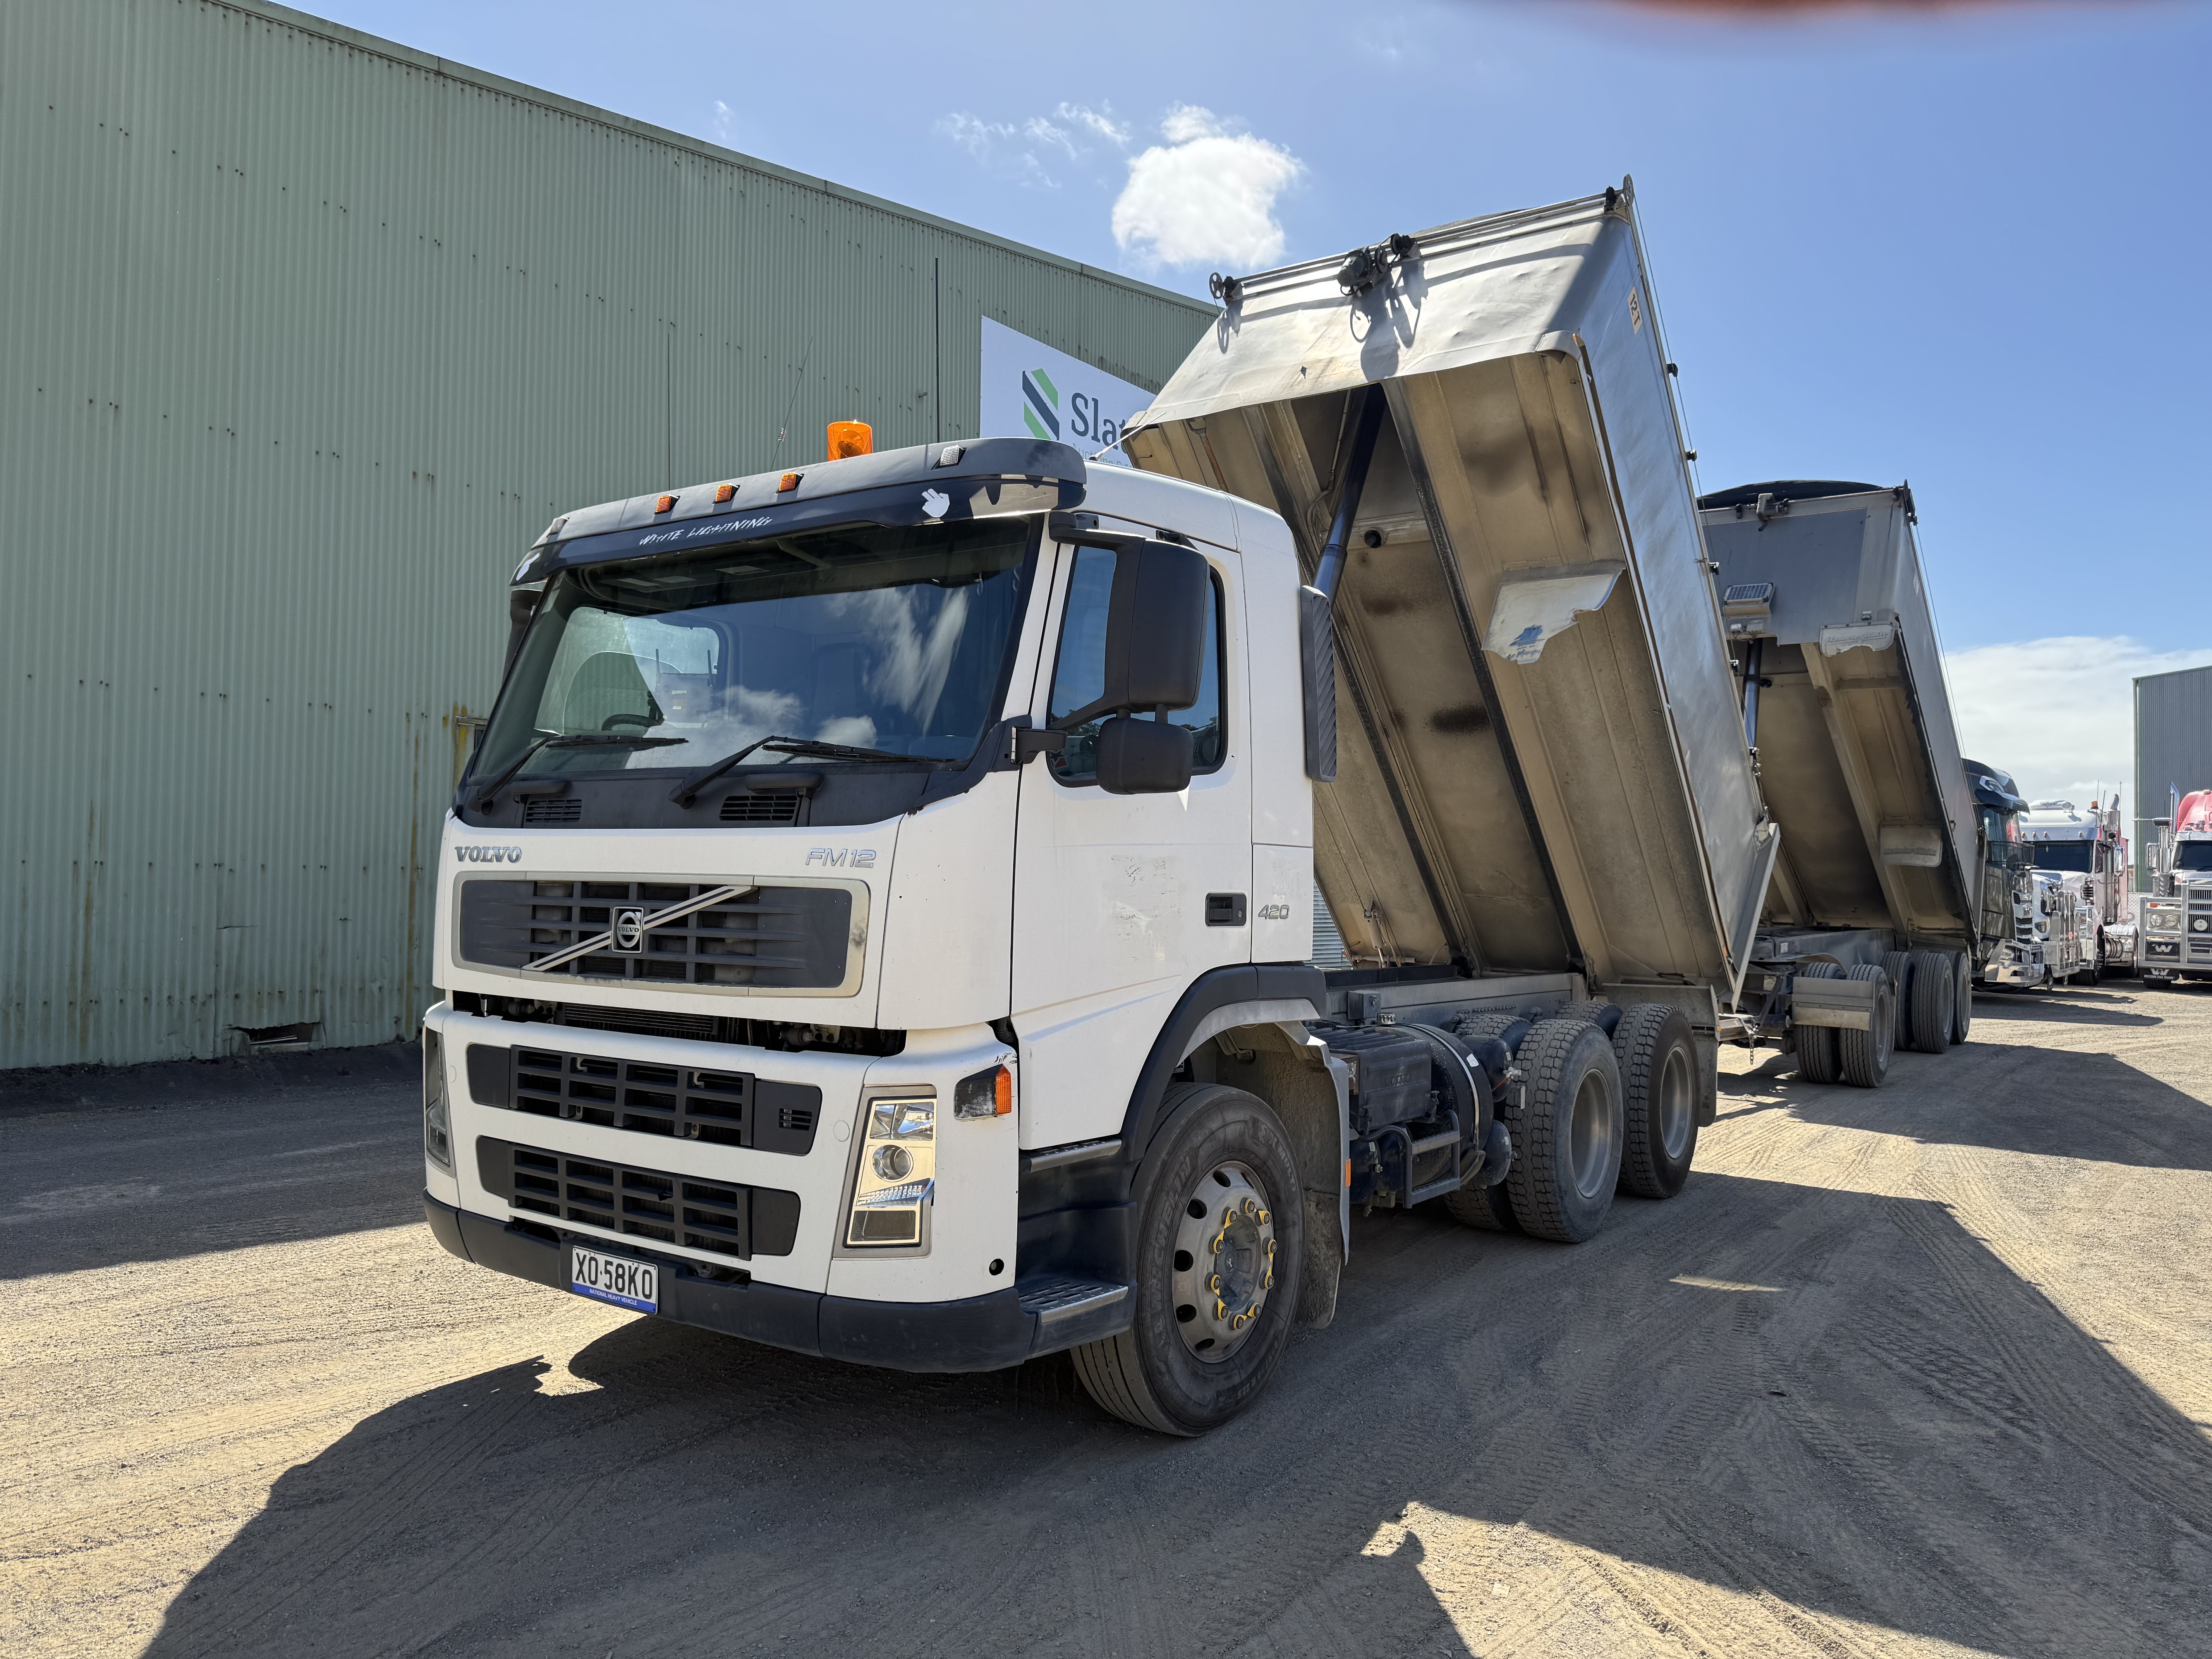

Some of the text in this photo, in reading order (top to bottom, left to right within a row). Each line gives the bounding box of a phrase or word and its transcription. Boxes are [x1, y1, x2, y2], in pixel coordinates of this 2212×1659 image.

[1630, 294, 1640, 326] 12T
[639, 529, 685, 546] WHITE
[455, 846, 522, 864] VOLVO
[1258, 905, 1290, 920] 420
[589, 1288, 637, 1305] NATIONAL HEAVY VEHICLE
